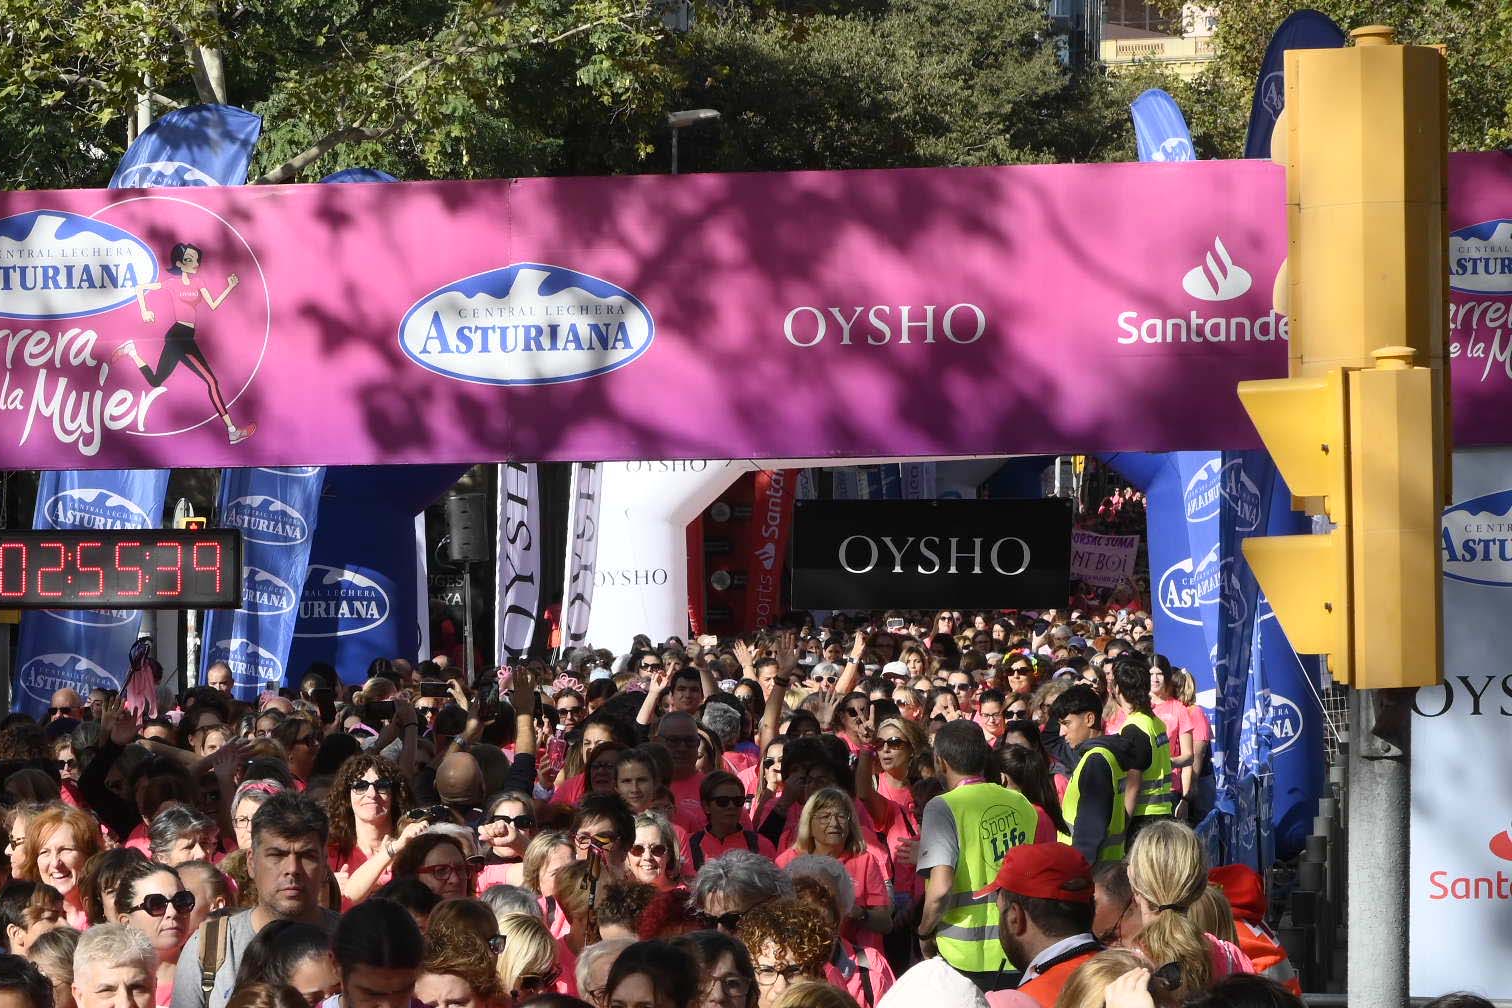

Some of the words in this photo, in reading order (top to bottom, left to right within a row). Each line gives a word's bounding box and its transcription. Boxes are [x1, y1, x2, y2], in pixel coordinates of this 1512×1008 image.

[62, 247, 133, 258] LECHERA
[419, 309, 634, 355] ASTURIANA
[457, 306, 534, 320] CENTRAL
[545, 304, 625, 318] LECHERA
[784, 302, 986, 347] OYSHO
[1118, 308, 1288, 344] Santande
[0, 373, 24, 410] la
[19, 362, 168, 457] Mujer
[0, 541, 221, 596] 02:55:39
[838, 535, 1031, 576] OYSHO
